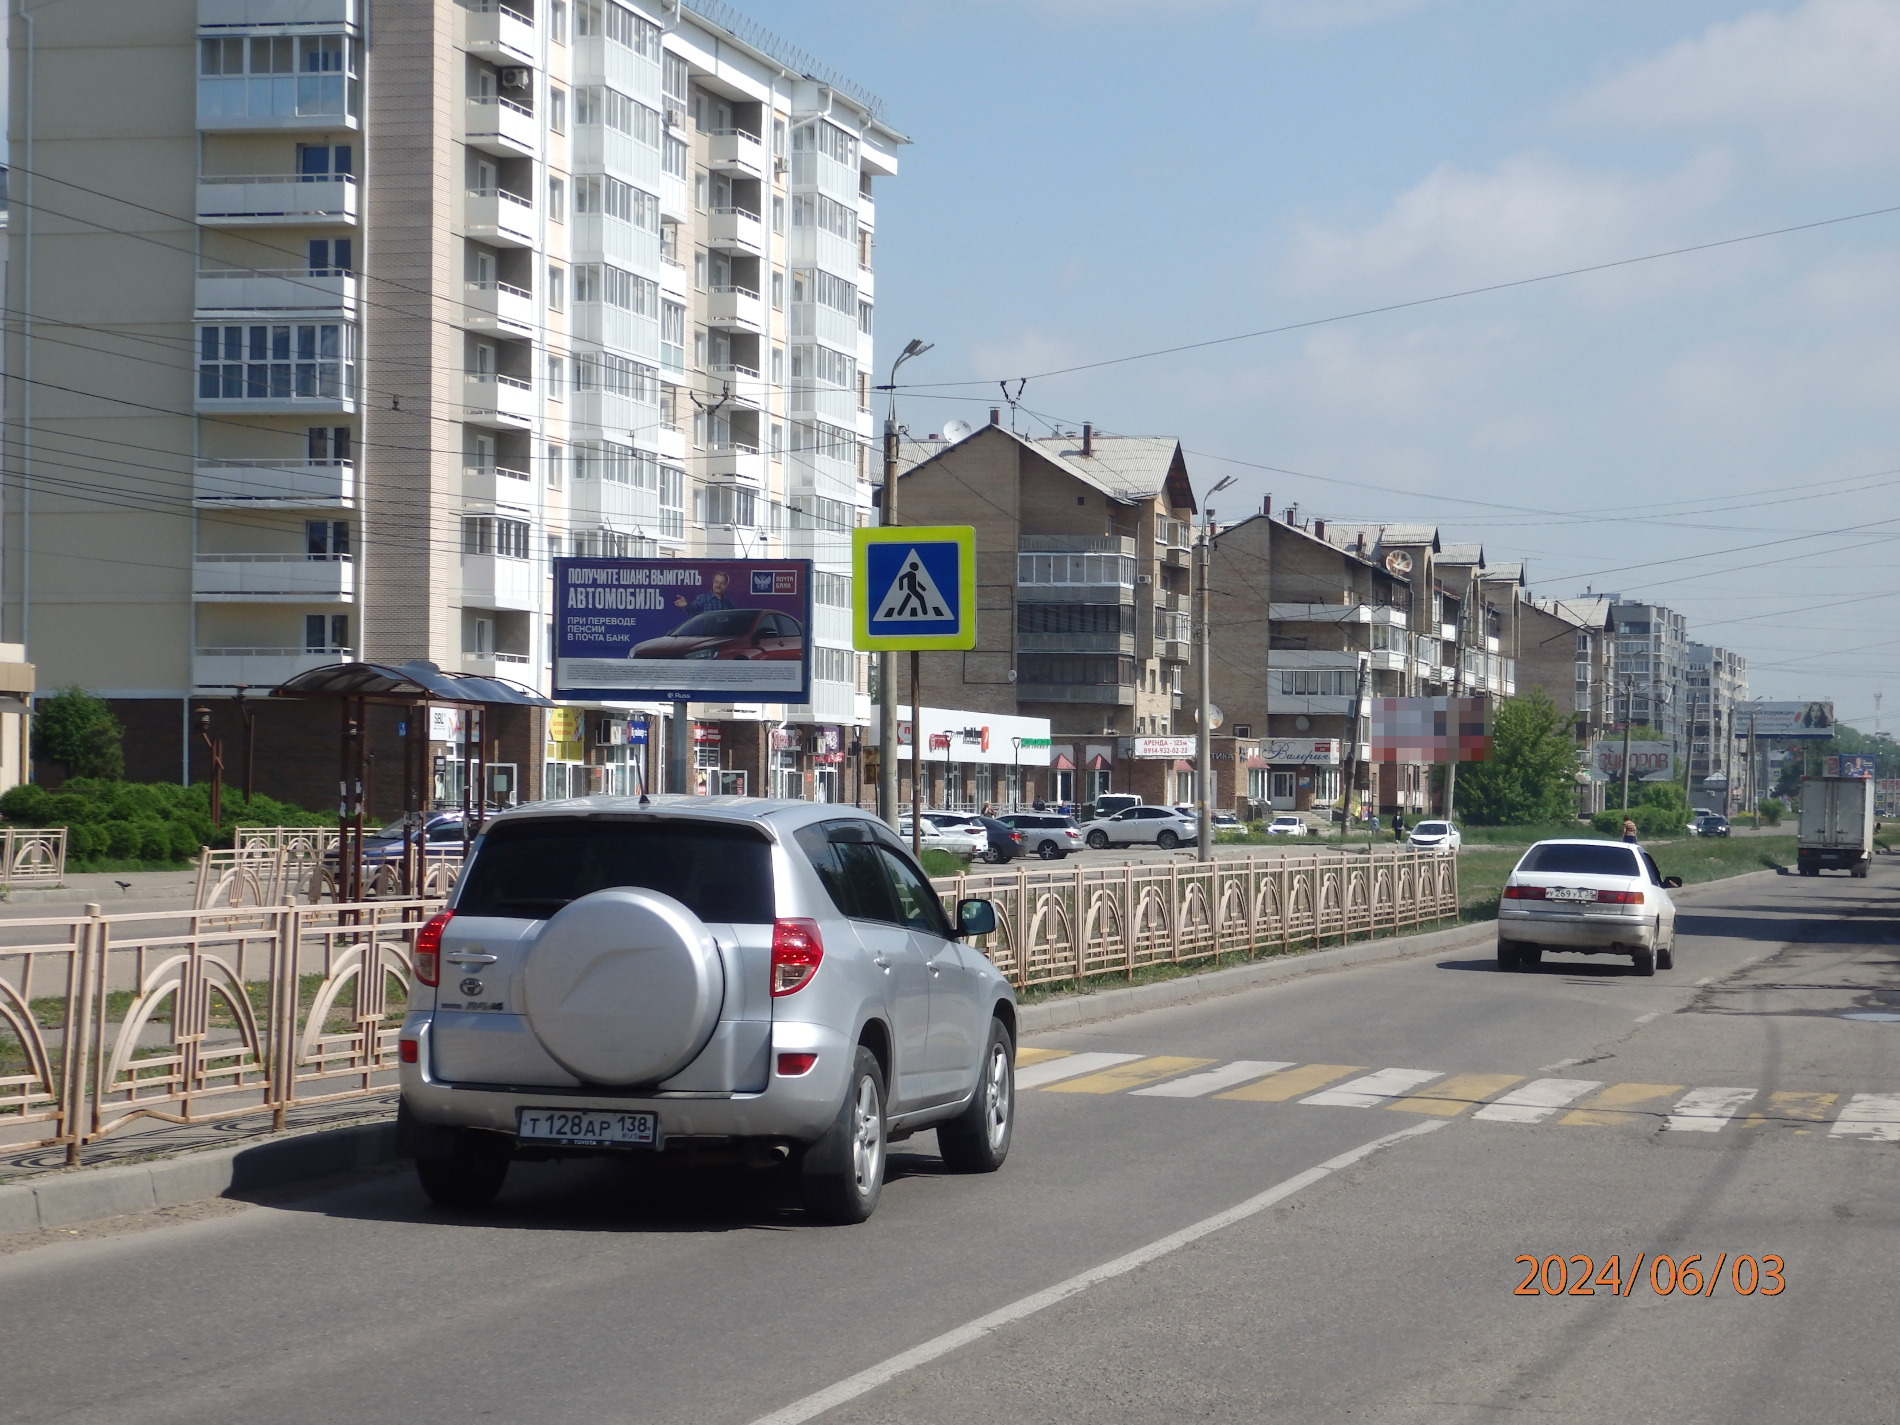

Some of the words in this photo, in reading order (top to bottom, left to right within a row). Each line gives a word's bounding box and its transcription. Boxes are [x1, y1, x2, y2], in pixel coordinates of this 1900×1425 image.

[568, 568, 618, 584] ПОЛУЧИТЕ
[620, 569, 649, 585] ШАНС
[650, 570, 702, 586] ВЫИГРАТЬ
[568, 588, 664, 610] АВТОМОБИЛЬ
[568, 617, 586, 625] ПРИ
[588, 617, 636, 626] ПЕРЕВОДЕ
[1266, 742, 1331, 765] Валерия
[1599, 753, 1669, 770] СУОРОВ
[616, 1116, 648, 1133] 138
